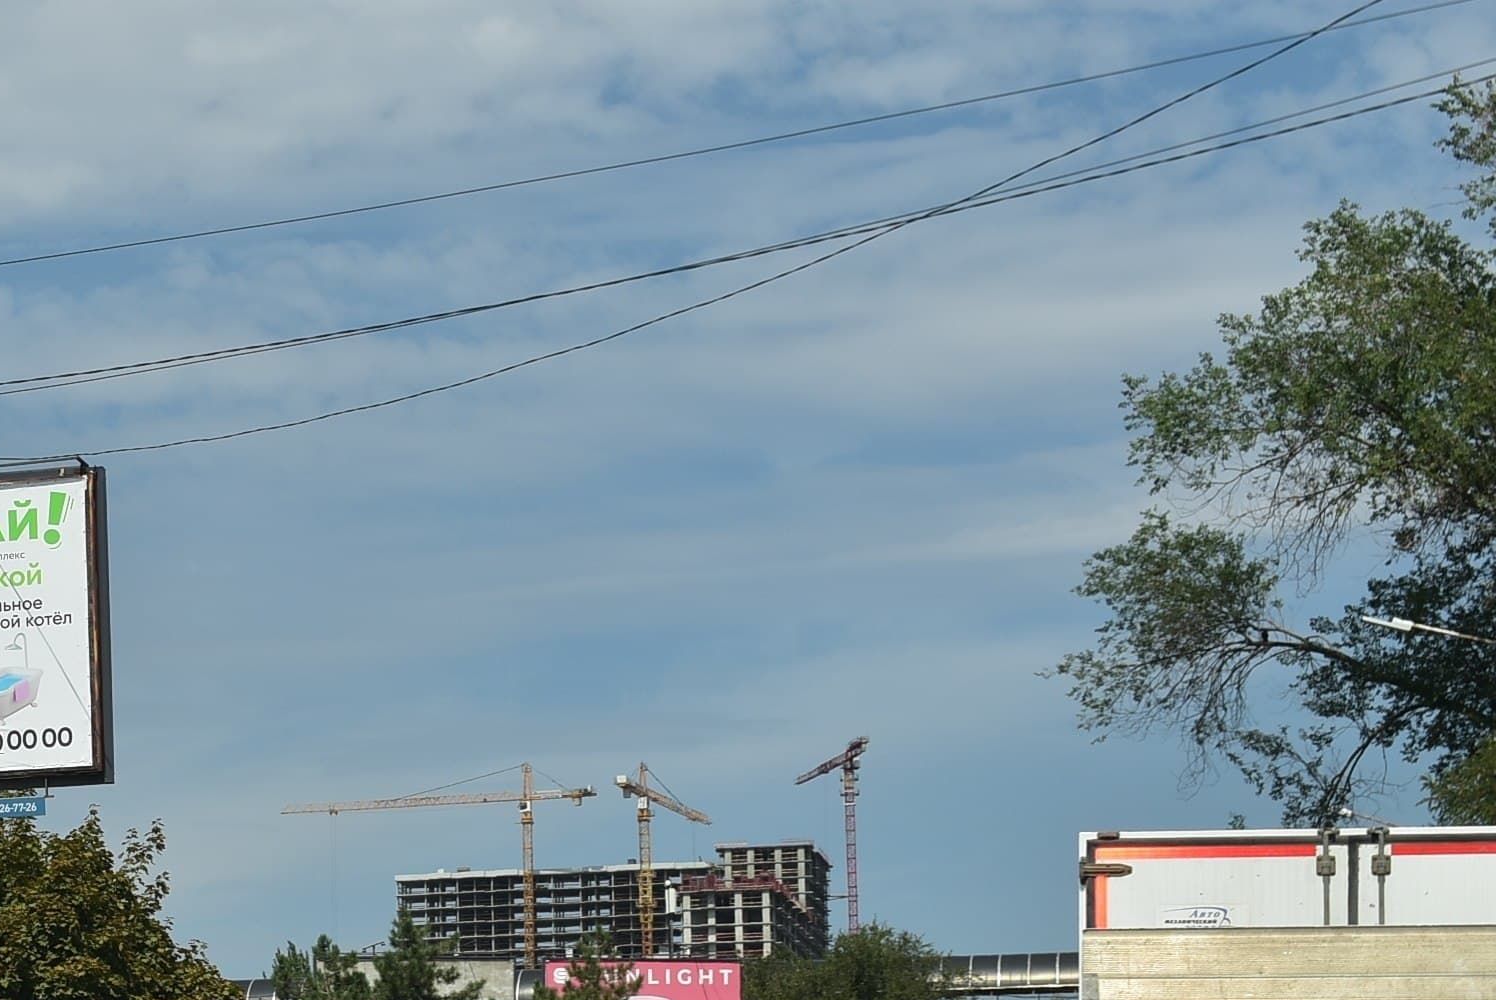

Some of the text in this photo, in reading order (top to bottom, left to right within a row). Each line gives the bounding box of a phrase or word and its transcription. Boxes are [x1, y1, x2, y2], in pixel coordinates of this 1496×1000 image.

[25, 612, 73, 628] котёл
[7, 729, 38, 750] 00
[42, 727, 73, 748] 00
